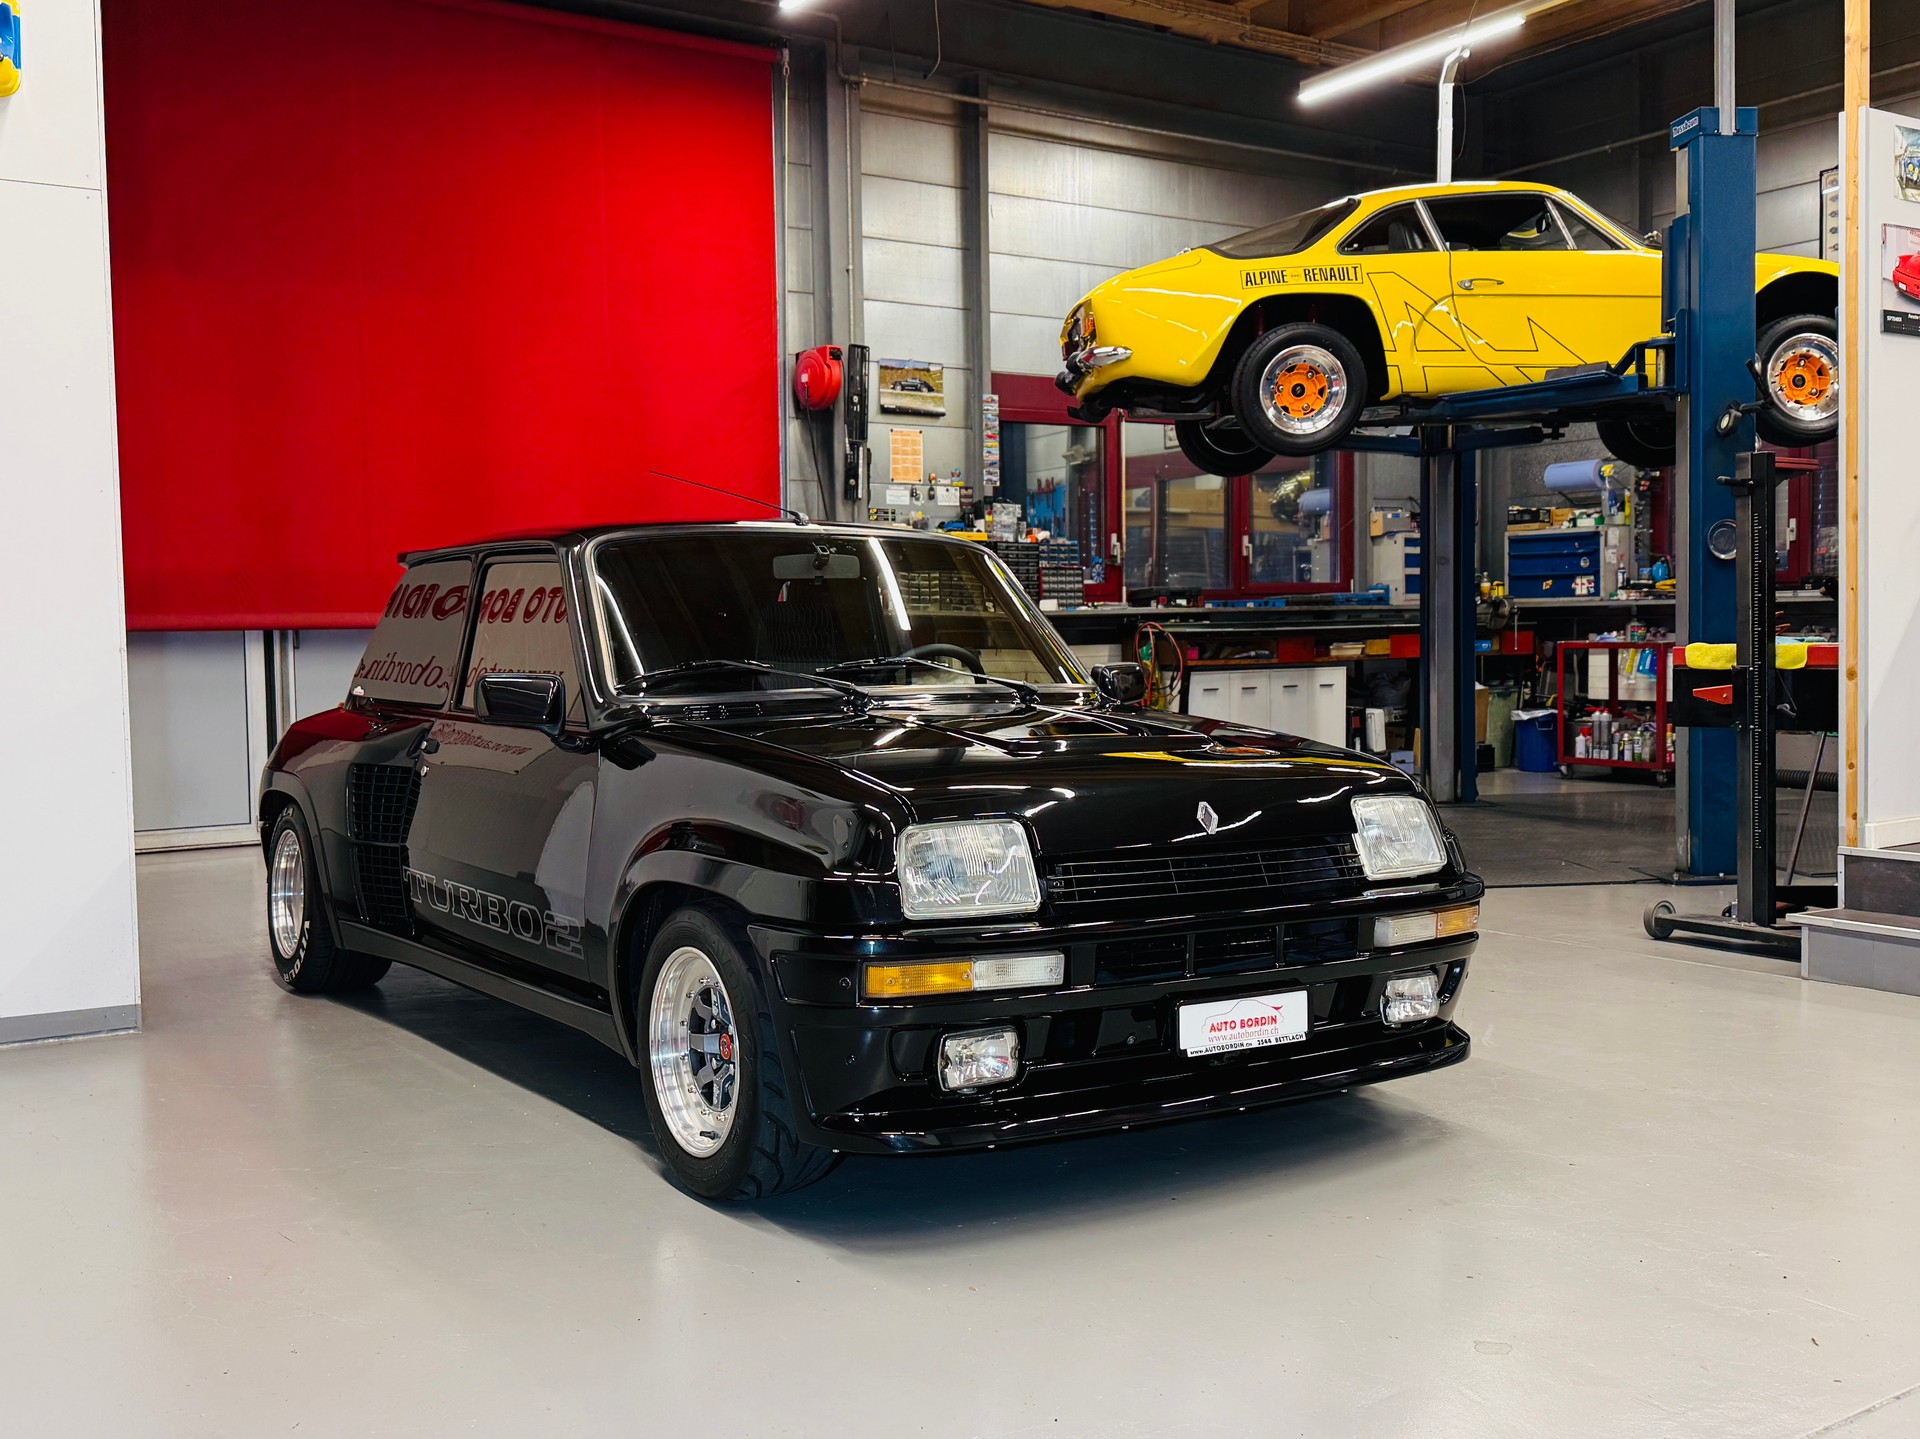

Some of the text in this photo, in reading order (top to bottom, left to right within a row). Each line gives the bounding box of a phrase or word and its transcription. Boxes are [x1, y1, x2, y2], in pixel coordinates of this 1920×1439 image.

[1245, 265, 1359, 287] ALPINE RENAULT
[1209, 1014, 1278, 1034] AUTO BORDIN
[1207, 1025, 1279, 1043] www.autobordin.ch
[1274, 1034, 1304, 1043] BETTLACH
